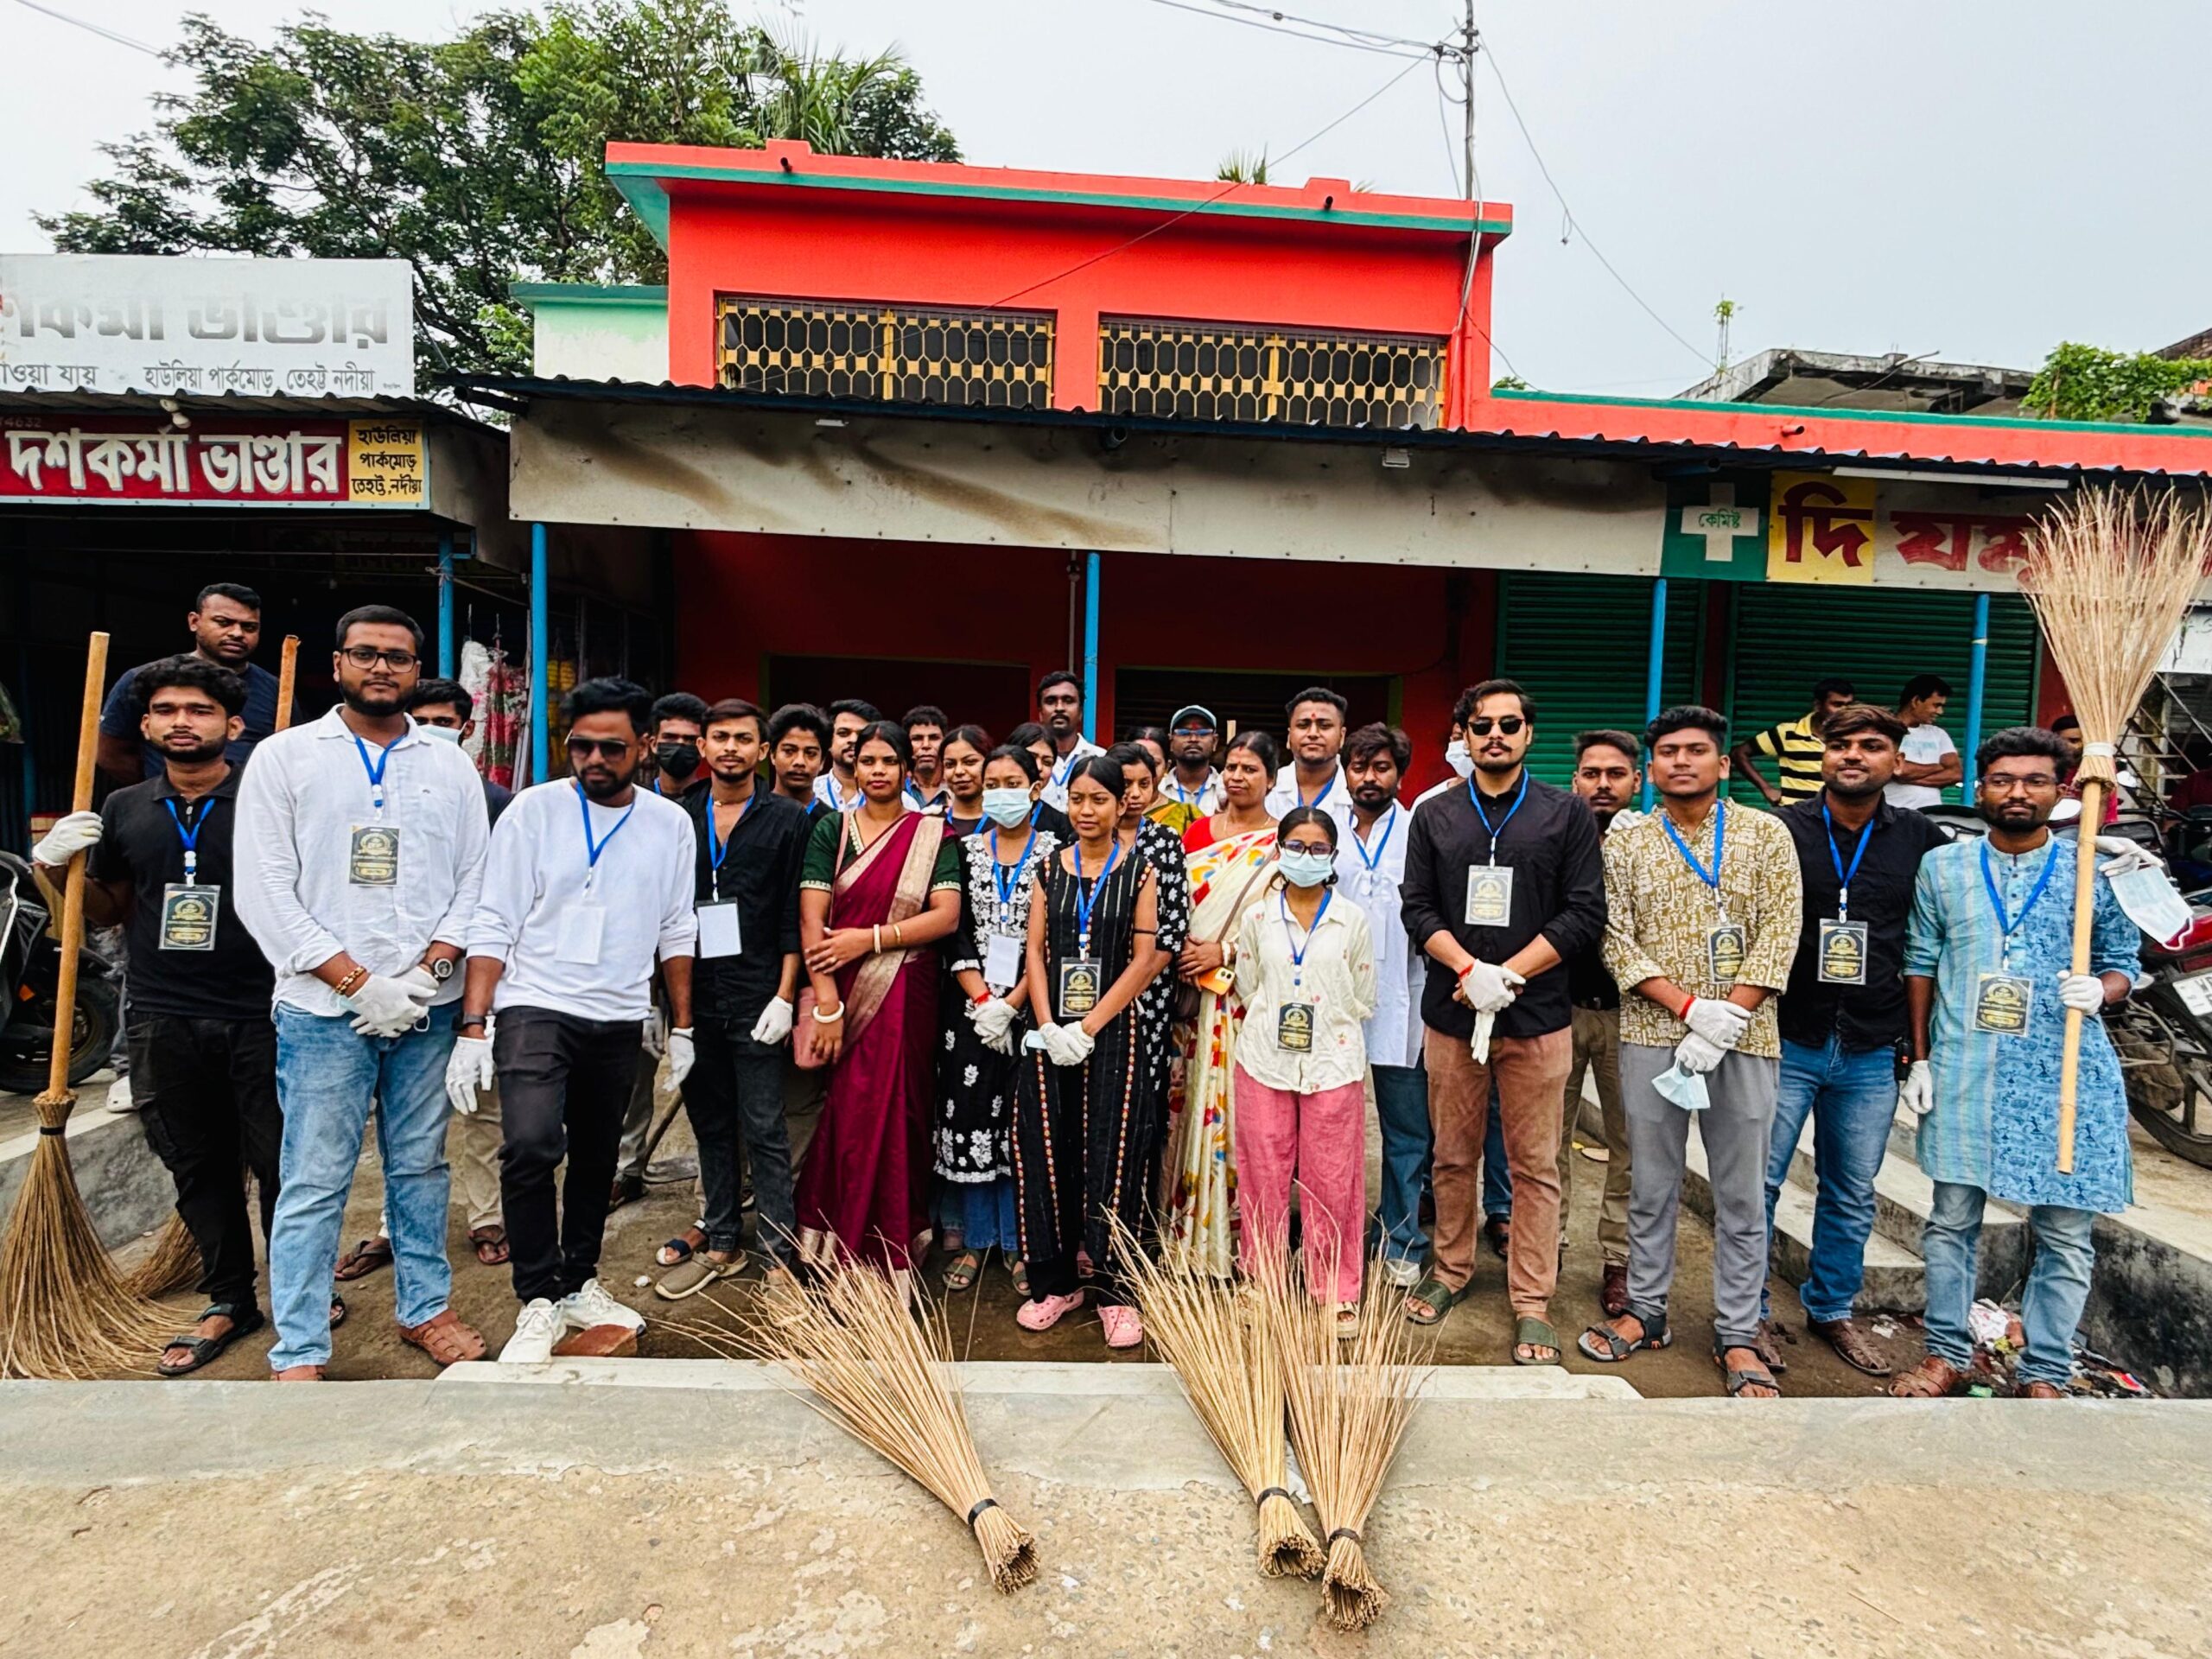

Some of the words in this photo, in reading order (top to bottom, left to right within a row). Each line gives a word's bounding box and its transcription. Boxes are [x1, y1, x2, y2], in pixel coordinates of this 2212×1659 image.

[0, 363, 51, 385] াওয়া
[57, 365, 99, 385] যায়
[143, 359, 203, 389] হাউলিয়া
[333, 361, 375, 391] নদীয়া
[356, 425, 418, 445] হাউলিয়া
[5, 424, 190, 493] দশকর্মা
[200, 431, 342, 493] ভাণ্ডার
[359, 451, 417, 472] পার্কমোড়
[1777, 480, 1873, 568] দি
